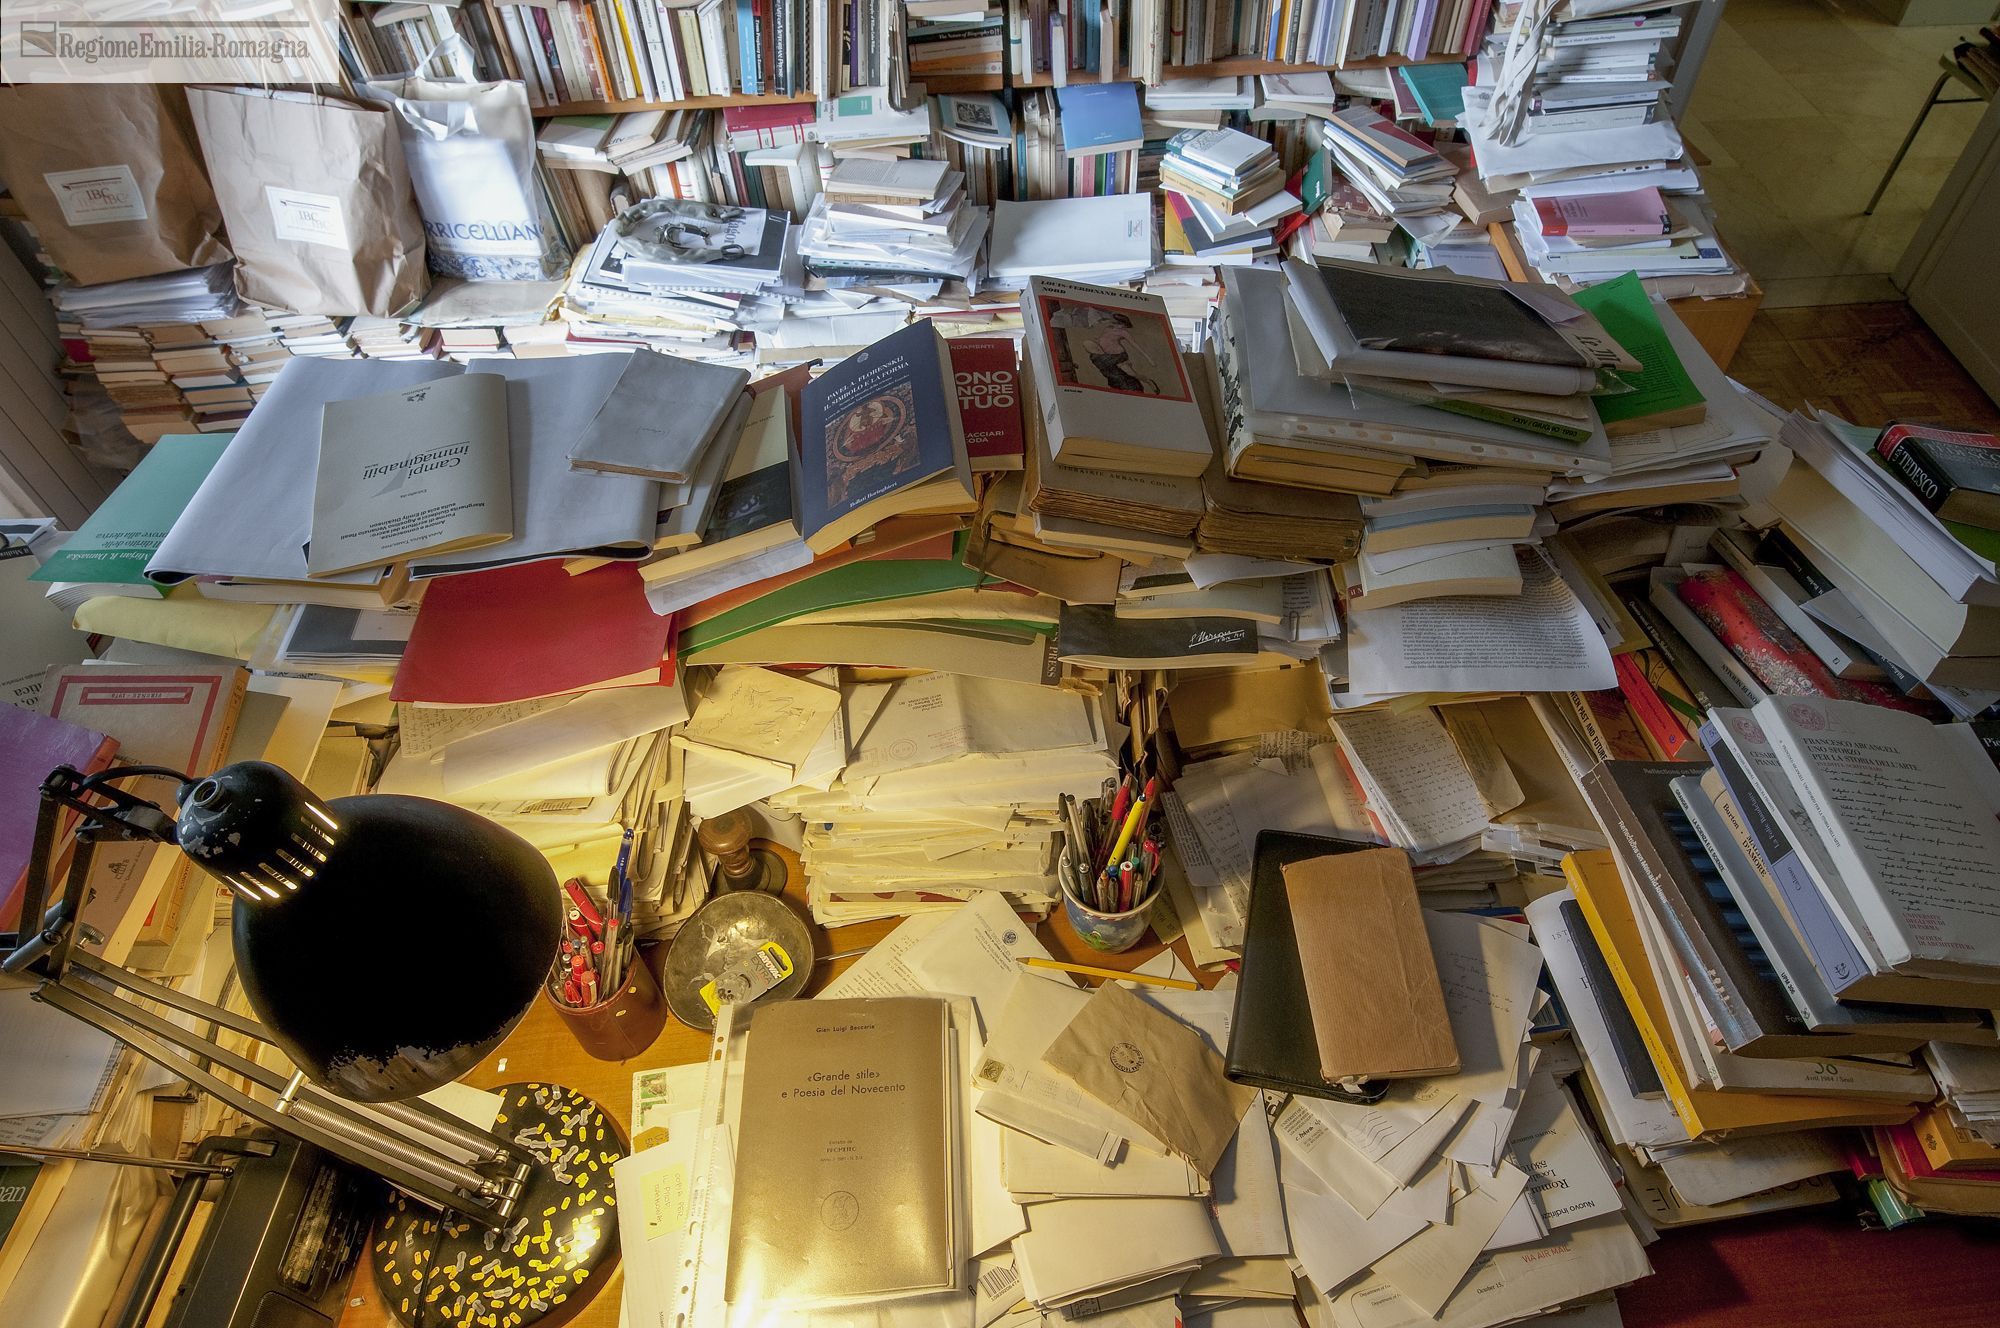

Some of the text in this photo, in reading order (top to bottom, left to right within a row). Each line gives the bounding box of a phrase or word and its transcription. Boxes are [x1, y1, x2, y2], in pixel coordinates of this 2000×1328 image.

[87, 188, 110, 200] IBC
[299, 210, 318, 222] IBC
[425, 221, 544, 241] RRICELLIAN
[1041, 280, 1149, 302] LOUIS-FERDINAND CÉLINE
[1043, 287, 1066, 295] NORD
[827, 384, 848, 401] PAVEL
[831, 385, 863, 408] SIMBOLO
[882, 362, 909, 378] FORMA
[958, 395, 1014, 409] TUO
[363, 445, 469, 480] immaginabili
[407, 457, 461, 479] Campi
[1898, 450, 1938, 499] TEDESCO
[1150, 480, 1177, 489] COLIN
[66, 552, 109, 562] Damaška
[109, 552, 118, 561] R.
[1046, 645, 1058, 679] PRESS
[1720, 664, 1742, 687] NEWMAN
[1577, 705, 1589, 723] PAST
[1586, 722, 1596, 737] AND
[1592, 735, 1607, 760] FUTURE
[1803, 736, 1852, 749] FRANCESCO
[1807, 743, 1861, 757] UNO SFORZO
[1722, 802, 1768, 879] Burton D'AMORE
[750, 956, 773, 986] EXTRA
[757, 949, 783, 981] RAYOVAC
[832, 1025, 848, 1034] Luigi
[850, 1023, 876, 1032] Beccaria
[807, 1068, 881, 1083] «Grande stile»
[781, 1082, 907, 1099] e Poesia del Novecento
[1540, 1199, 1596, 1220] Nuovo indirizz
[1522, 1244, 1571, 1264] VIA AIR MAIL
[1476, 1284, 1497, 1295] October
